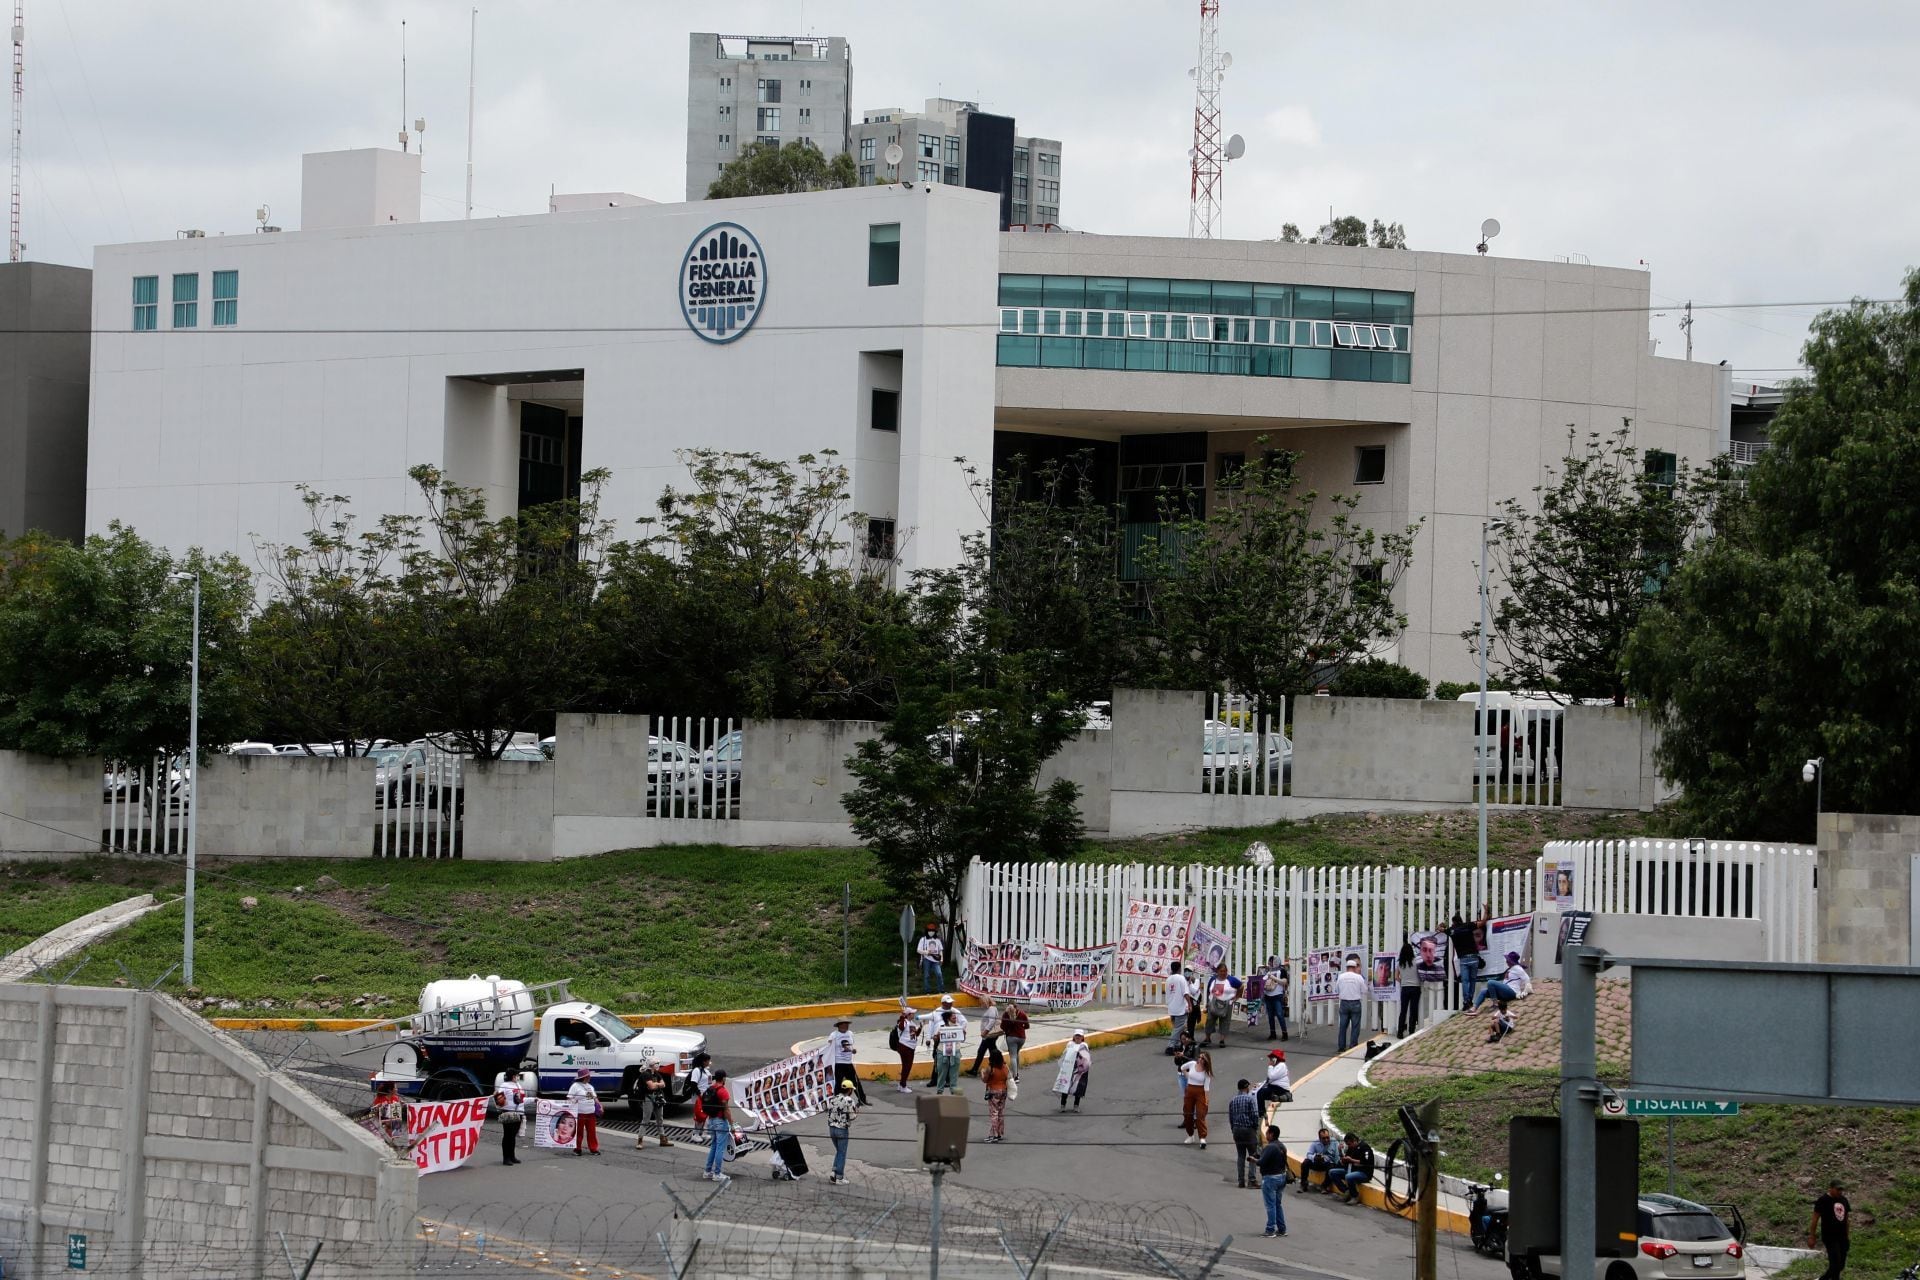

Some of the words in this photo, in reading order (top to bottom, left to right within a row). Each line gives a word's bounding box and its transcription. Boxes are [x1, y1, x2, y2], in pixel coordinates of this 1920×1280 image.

[689, 280, 755, 298] GENERAL
[770, 1061, 787, 1073] HAS
[409, 1127, 479, 1169] STAN
